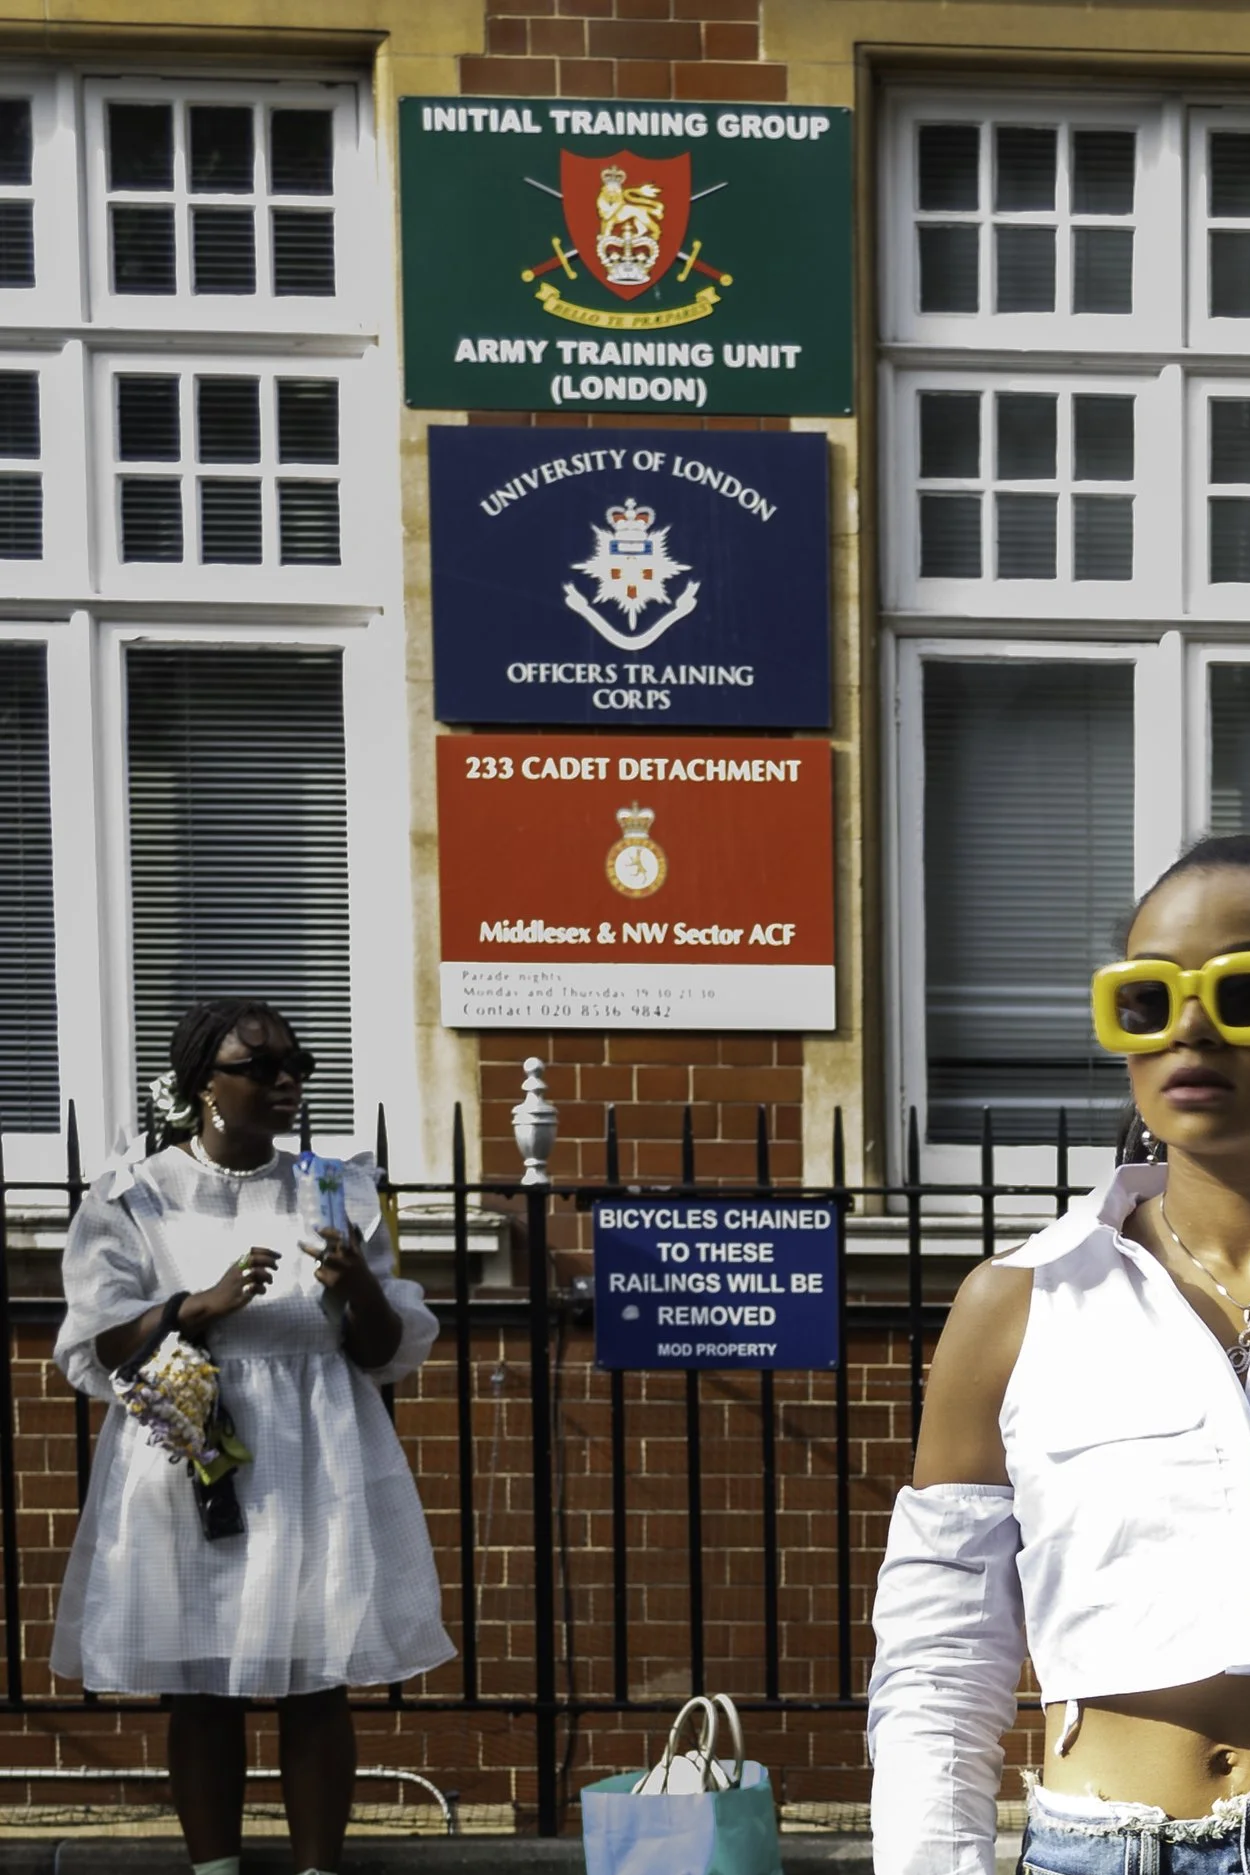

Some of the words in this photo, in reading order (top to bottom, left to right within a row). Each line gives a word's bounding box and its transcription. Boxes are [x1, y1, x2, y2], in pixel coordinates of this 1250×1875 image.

[422, 107, 541, 134] INITIAL
[550, 110, 707, 137] TRAINING
[717, 113, 830, 140] GROUP
[455, 339, 548, 364] ARMY
[557, 340, 714, 367] TRAINING
[724, 344, 801, 369] UNIT
[551, 376, 707, 407] (LONDON)
[480, 449, 627, 517] UNIVERSITY
[632, 449, 666, 473] OF
[672, 456, 778, 523] LONDON
[507, 662, 617, 684] OFFICERS
[623, 664, 754, 687] TRAINING
[593, 689, 671, 710] CORPS
[466, 757, 514, 779] 233
[522, 757, 610, 781] CADET
[619, 758, 801, 783] DETACHMENT
[480, 920, 591, 944] Middlesex
[597, 922, 616, 944] &
[622, 922, 669, 944] NW
[674, 922, 743, 945] Sector
[749, 923, 796, 946] ACF
[462, 970, 509, 981] Parade
[528, 987, 553, 998] and
[541, 1004, 571, 1017] 020
[600, 1209, 718, 1229] BICYCLES
[724, 1210, 831, 1229] CHAINED
[656, 1243, 690, 1262] TO
[695, 1243, 774, 1262] THESE
[609, 1273, 721, 1293] RAILINGS
[726, 1273, 785, 1293] WILL
[791, 1273, 823, 1293] BE
[657, 1306, 776, 1325] REMOVED
[657, 1343, 692, 1356] MOD
[696, 1343, 777, 1356] PROPERTY
